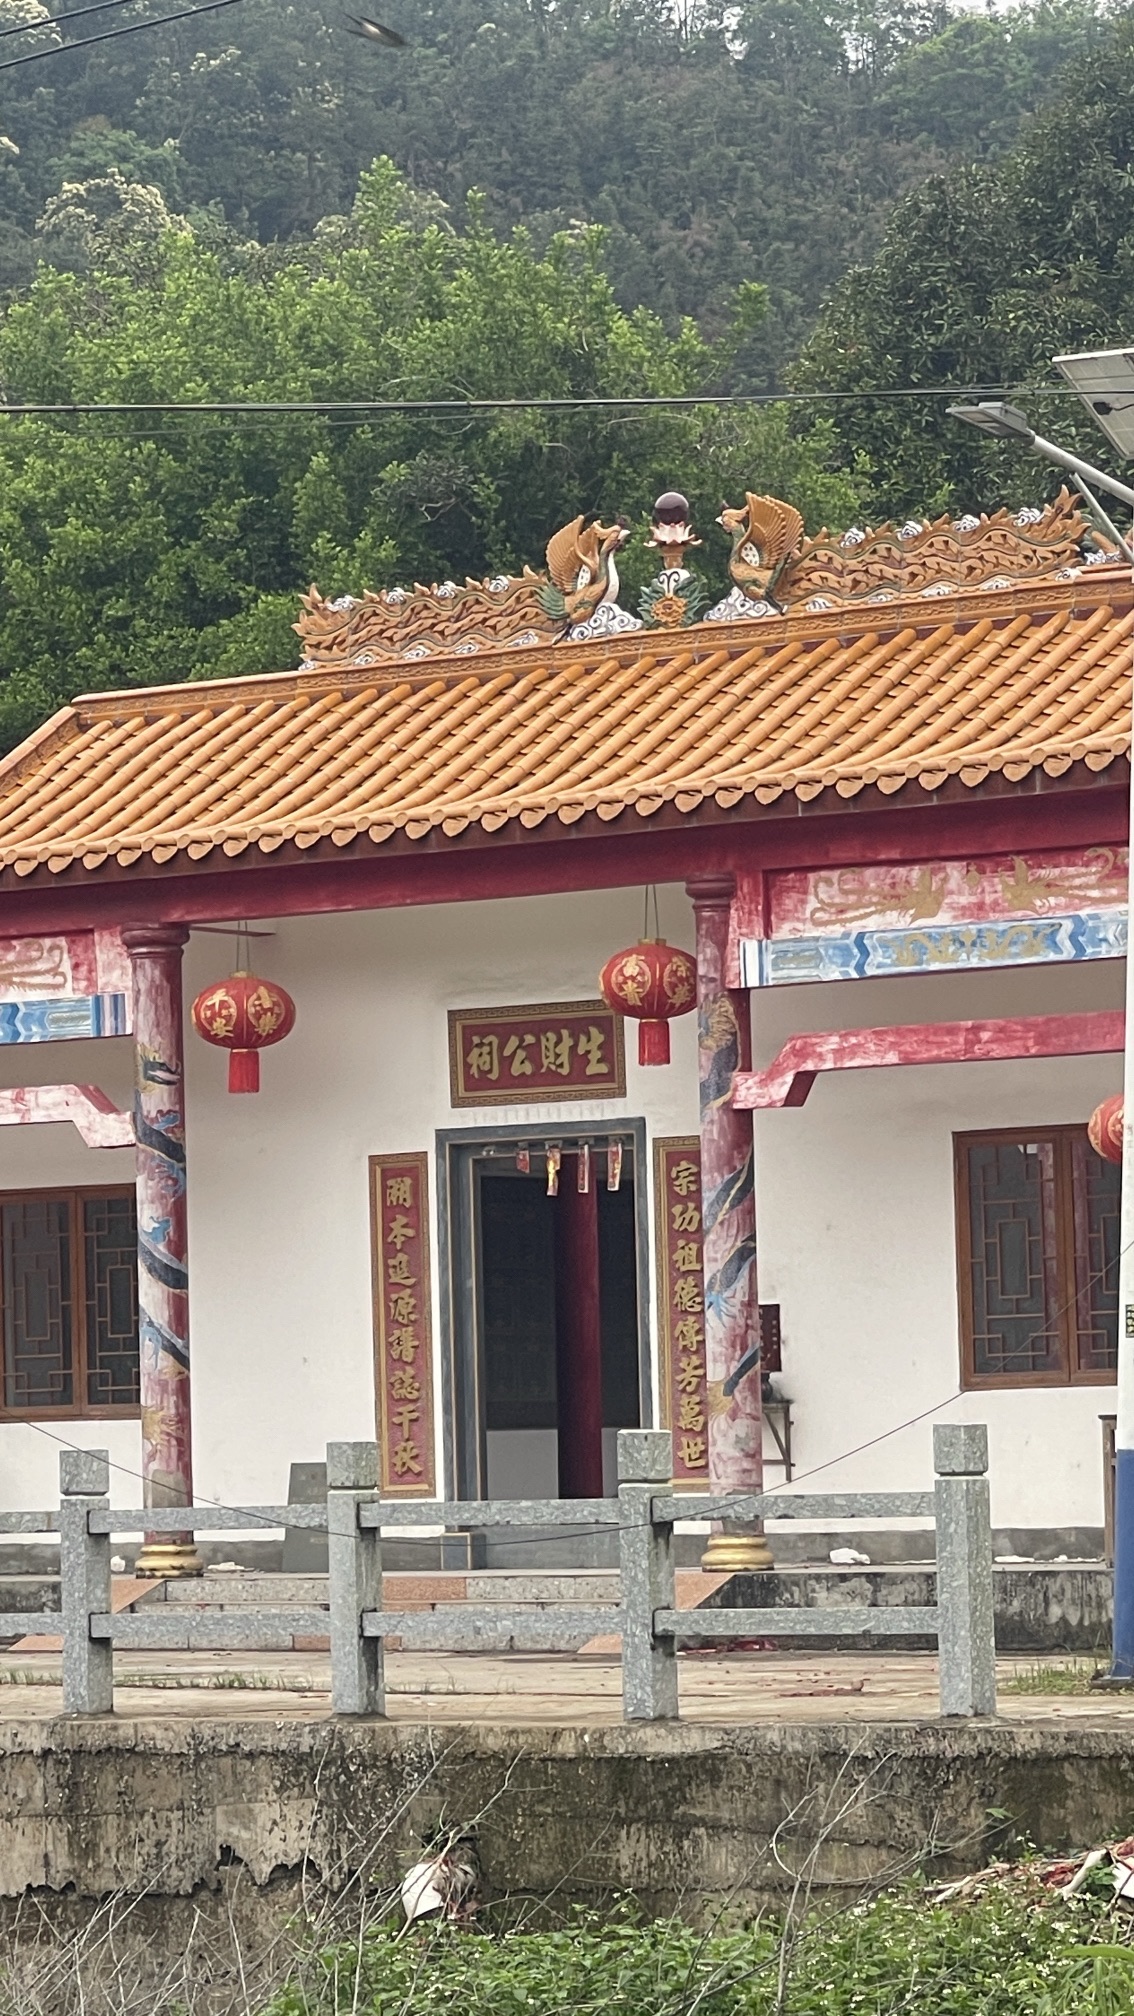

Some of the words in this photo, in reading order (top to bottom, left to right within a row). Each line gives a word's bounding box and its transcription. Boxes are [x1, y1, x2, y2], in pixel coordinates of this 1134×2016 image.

[670, 1159, 706, 1468] 宗功祖德傳芳萬世
